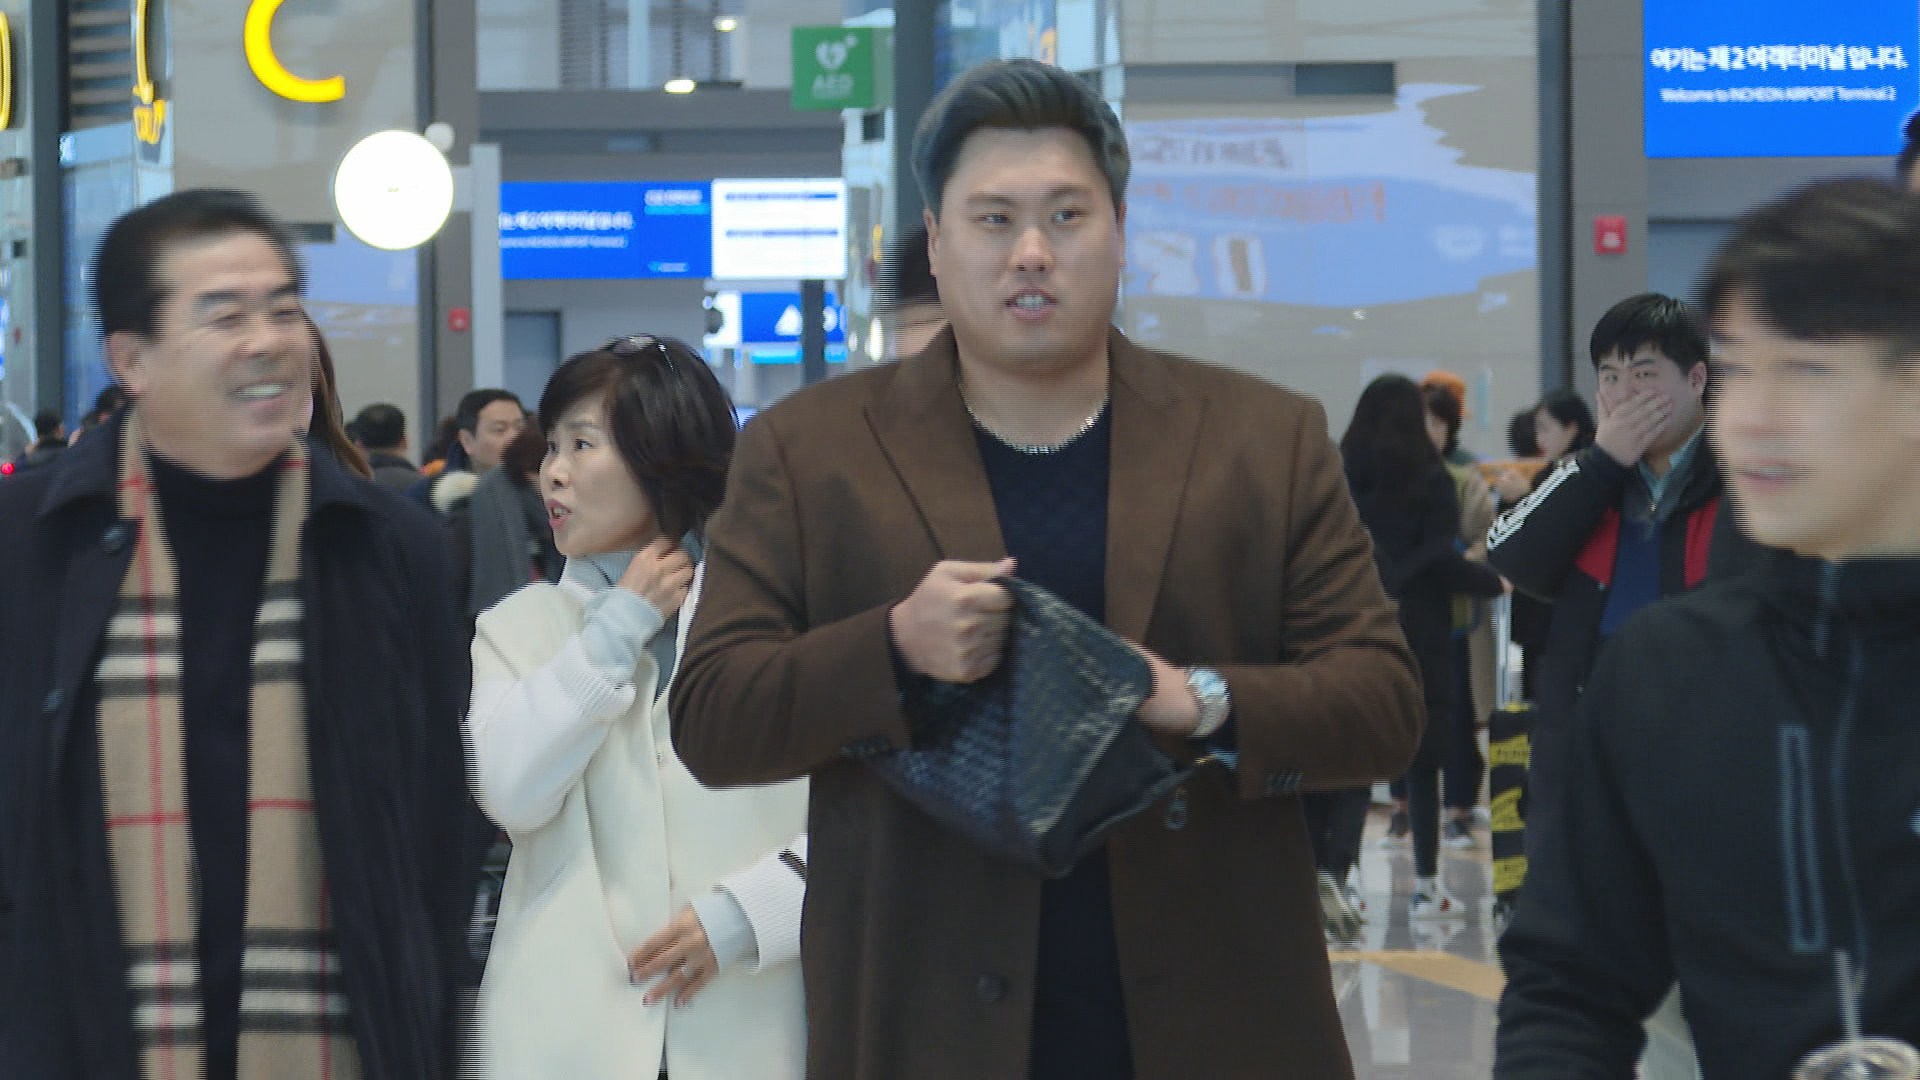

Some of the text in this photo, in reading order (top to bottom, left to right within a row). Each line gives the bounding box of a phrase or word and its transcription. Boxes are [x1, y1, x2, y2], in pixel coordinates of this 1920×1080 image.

[1650, 46, 1706, 72] 여기는
[1746, 44, 1846, 71] 여객터미널
[1660, 86, 1897, 102] Welcome to INCHEON AIRPORT Terminal 2
